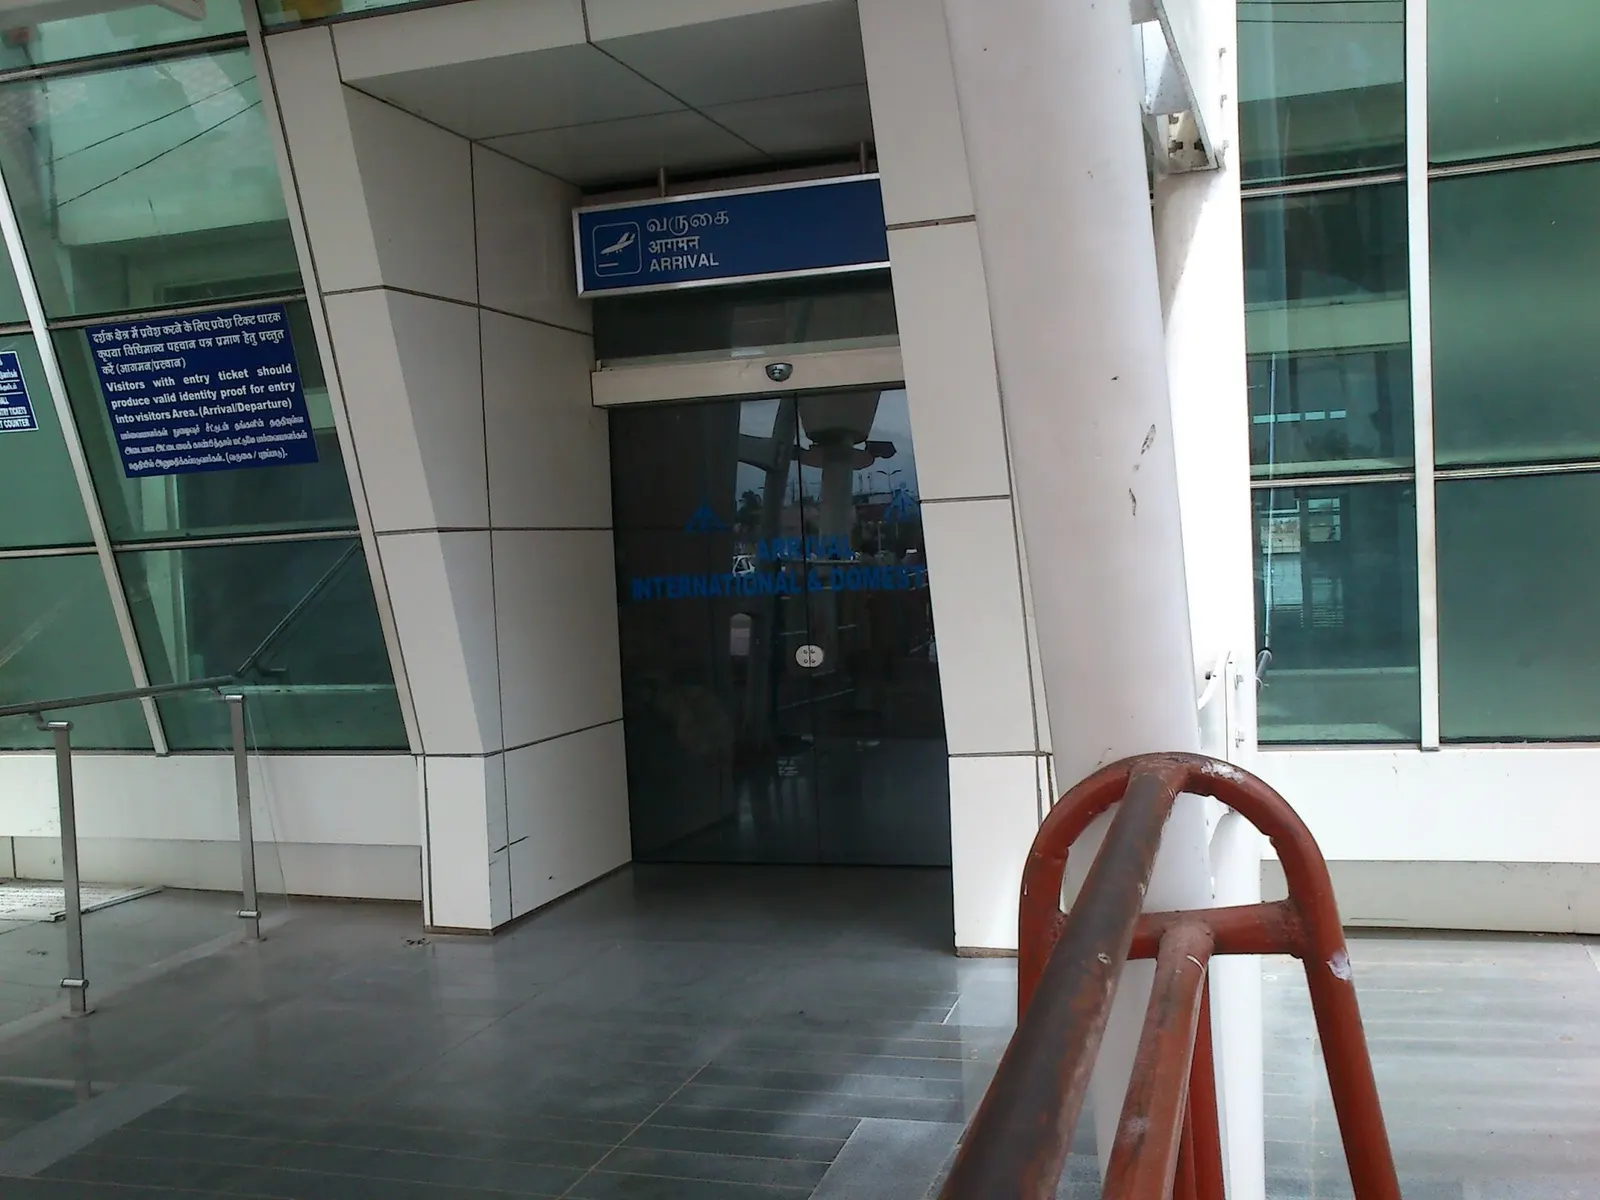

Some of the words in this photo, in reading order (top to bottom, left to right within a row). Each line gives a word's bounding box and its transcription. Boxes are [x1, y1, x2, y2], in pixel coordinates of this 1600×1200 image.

[647, 210, 729, 236] வருகை
[649, 236, 699, 254] आगमन
[650, 253, 719, 272] ARRIVAL
[106, 380, 145, 393] Visitors
[153, 377, 175, 388] with
[183, 373, 209, 386] entry
[218, 369, 249, 381] ticket
[257, 364, 292, 377] should
[111, 397, 150, 410] produce
[153, 393, 176, 404] valid
[179, 389, 217, 402] identity
[220, 386, 247, 400] proof
[250, 386, 264, 394] for
[268, 381, 295, 393] entry
[115, 413, 134, 423] into
[135, 409, 171, 421] visitors
[172, 407, 198, 419] Area.
[199, 398, 292, 418] (Arrival/Departure)
[4, 419, 30, 428] COUNTER
[631, 572, 801, 600] INTERNATIONAL
[807, 574, 824, 592] &
[830, 566, 924, 590] DOMEST
